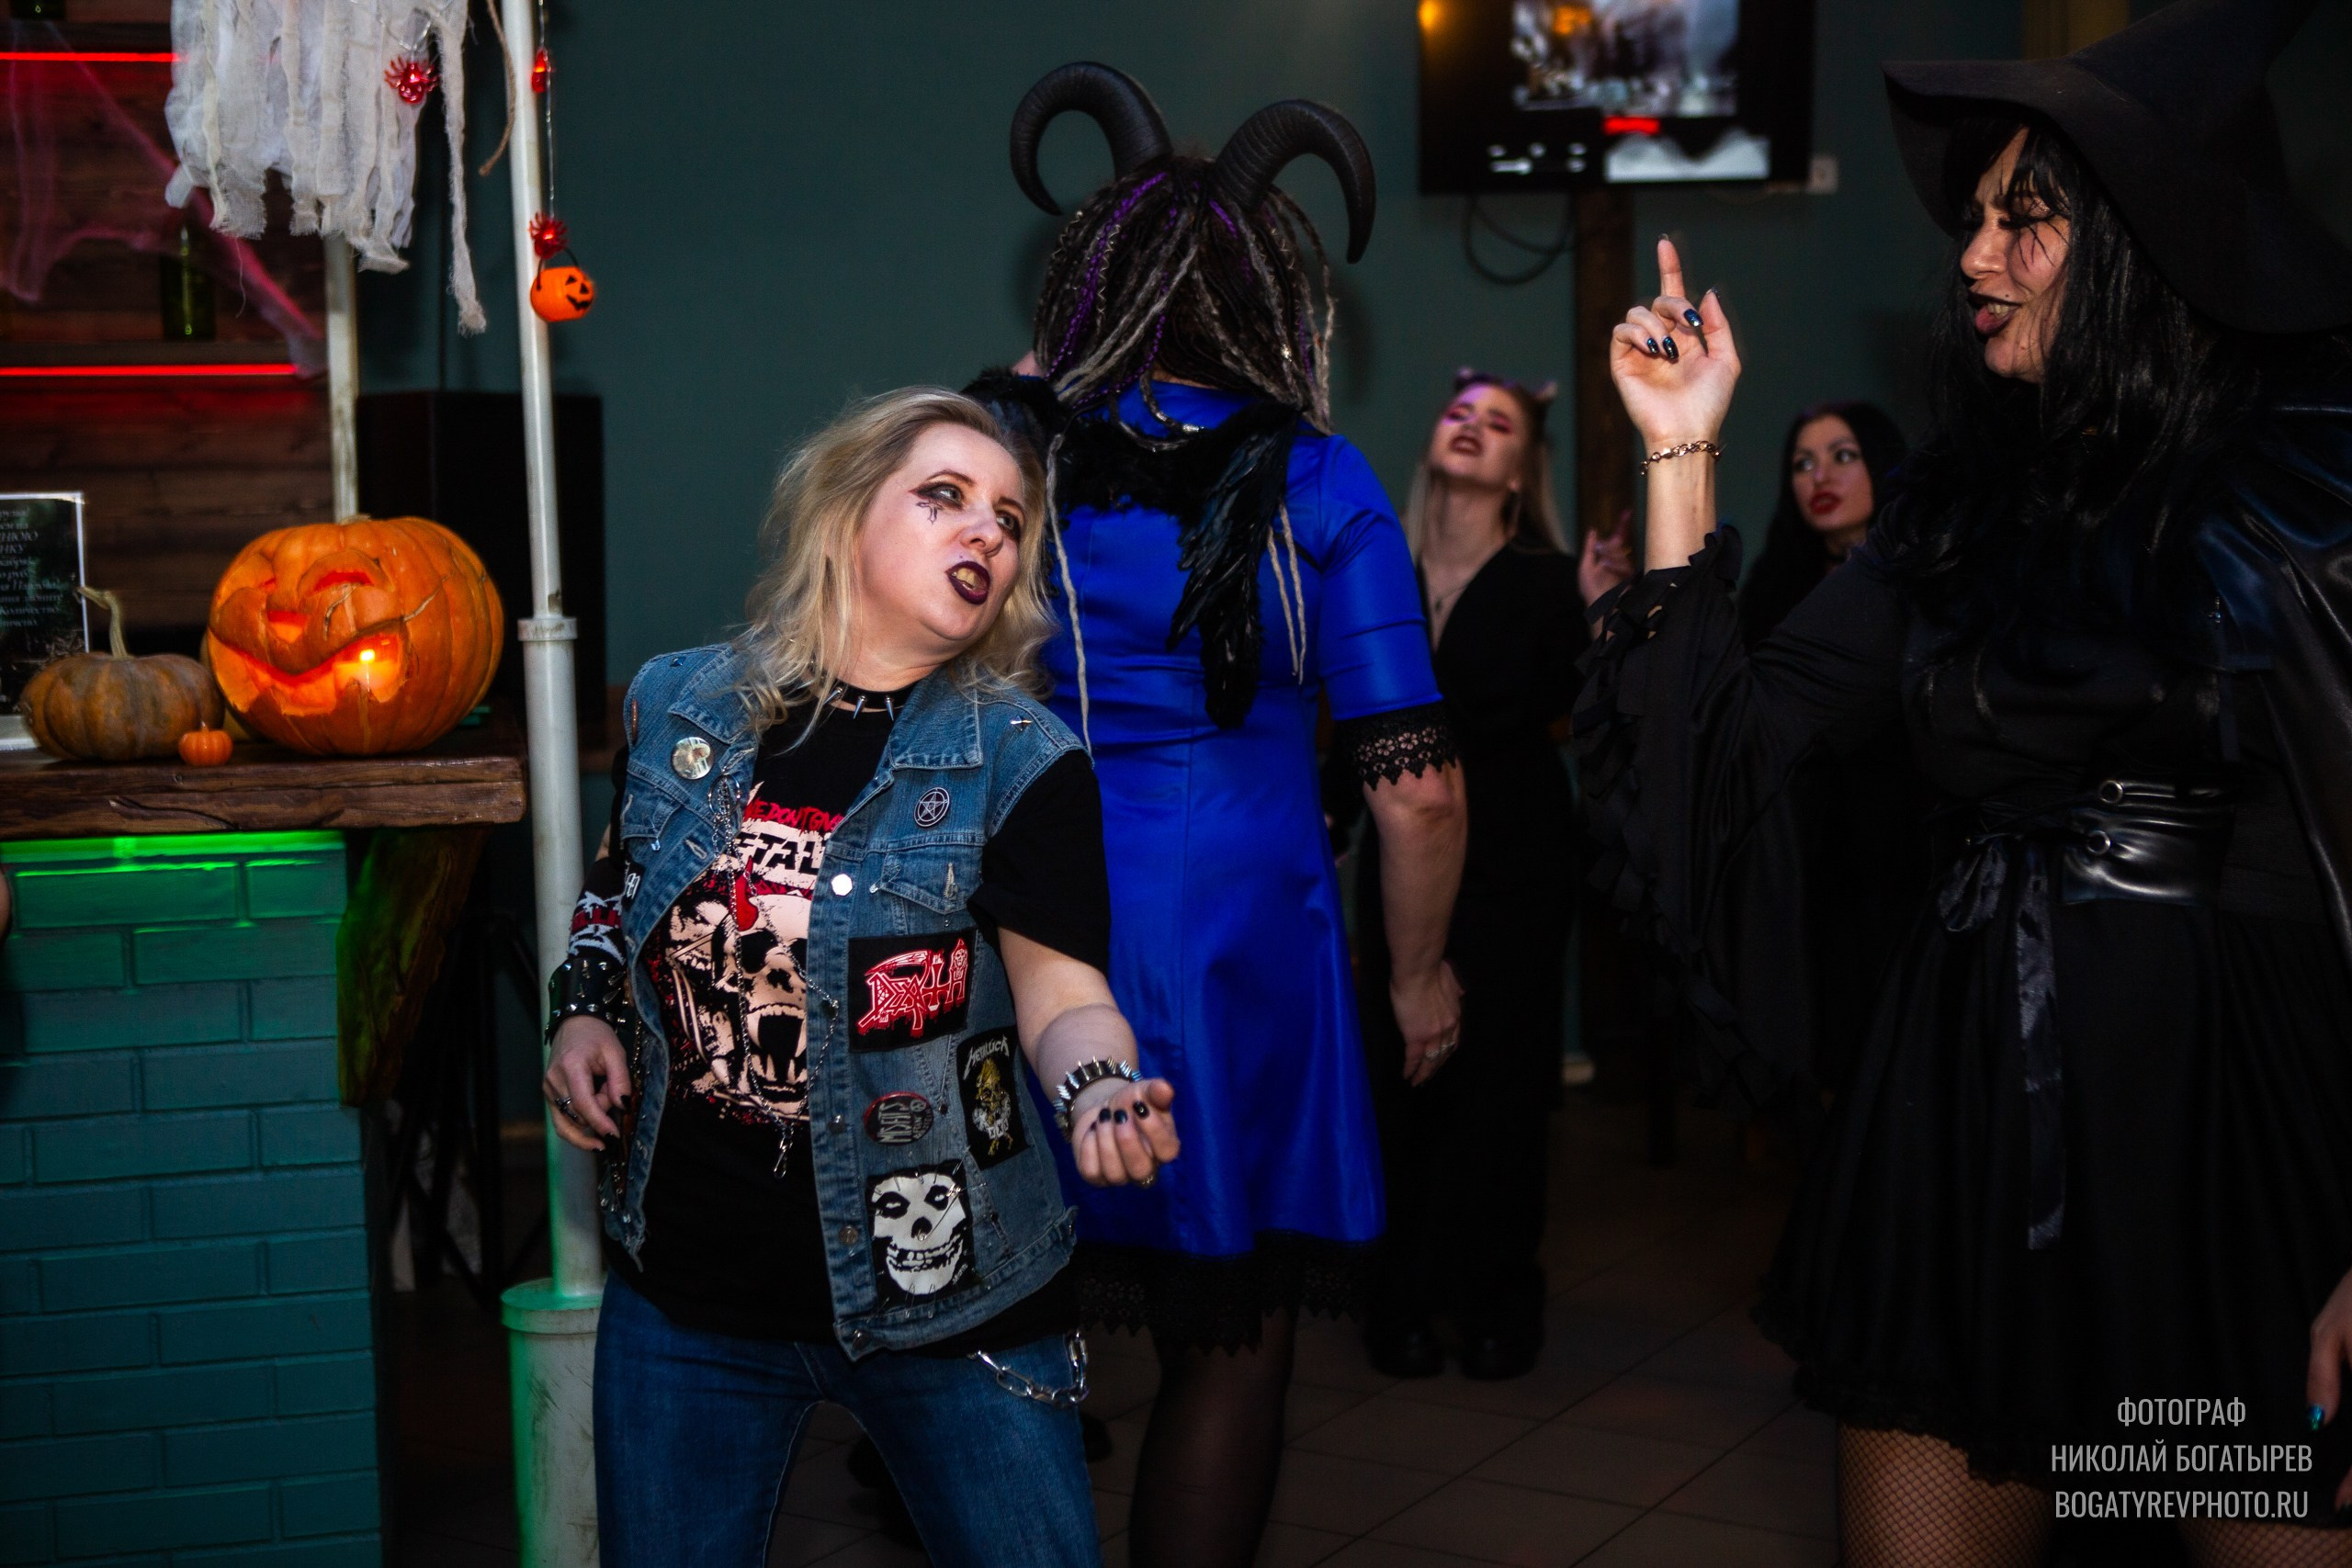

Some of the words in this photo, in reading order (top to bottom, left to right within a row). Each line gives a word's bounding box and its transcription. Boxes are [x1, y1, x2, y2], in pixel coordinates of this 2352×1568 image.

[730, 832, 819, 875] ETAL
[857, 939, 968, 1037] DEATH
[963, 1034, 1010, 1081] METALLICA
